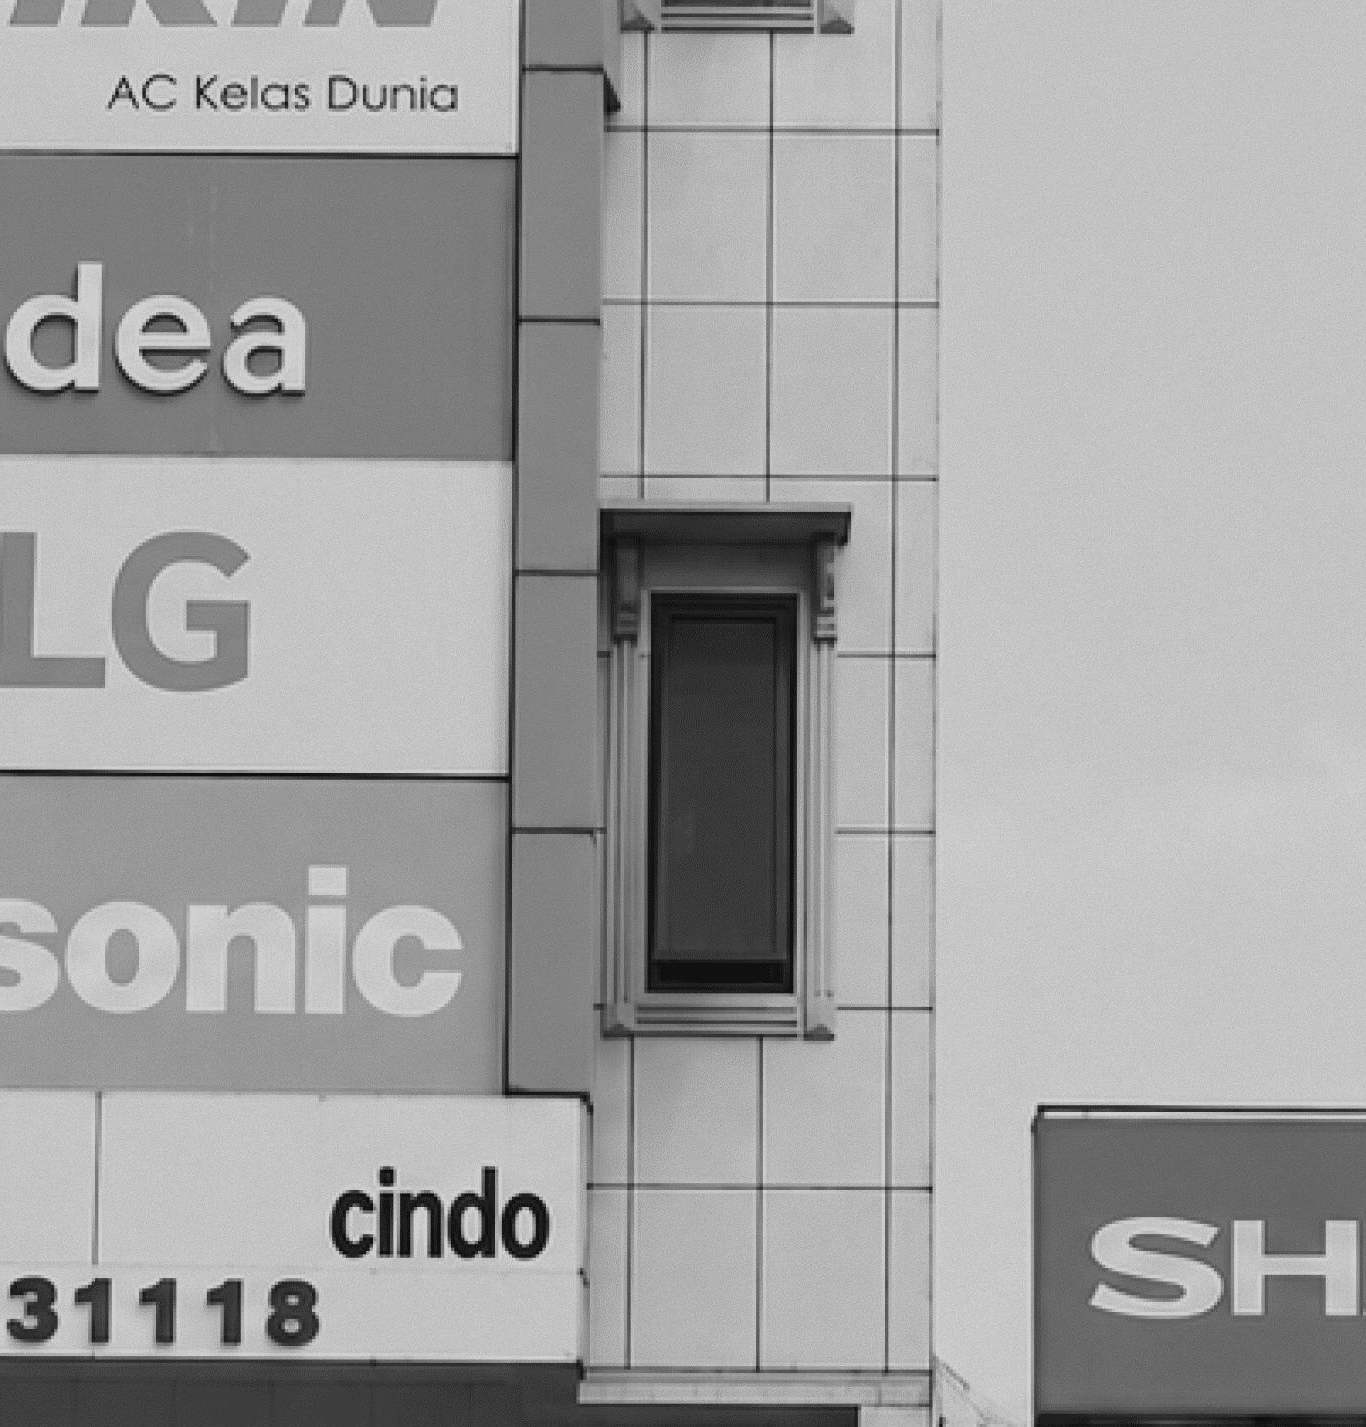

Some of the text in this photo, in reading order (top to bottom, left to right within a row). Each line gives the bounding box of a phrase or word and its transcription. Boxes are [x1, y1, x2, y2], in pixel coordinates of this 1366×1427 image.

[106, 73, 460, 113] AC Kelas Dunia
[329, 1166, 551, 1261] cindo
